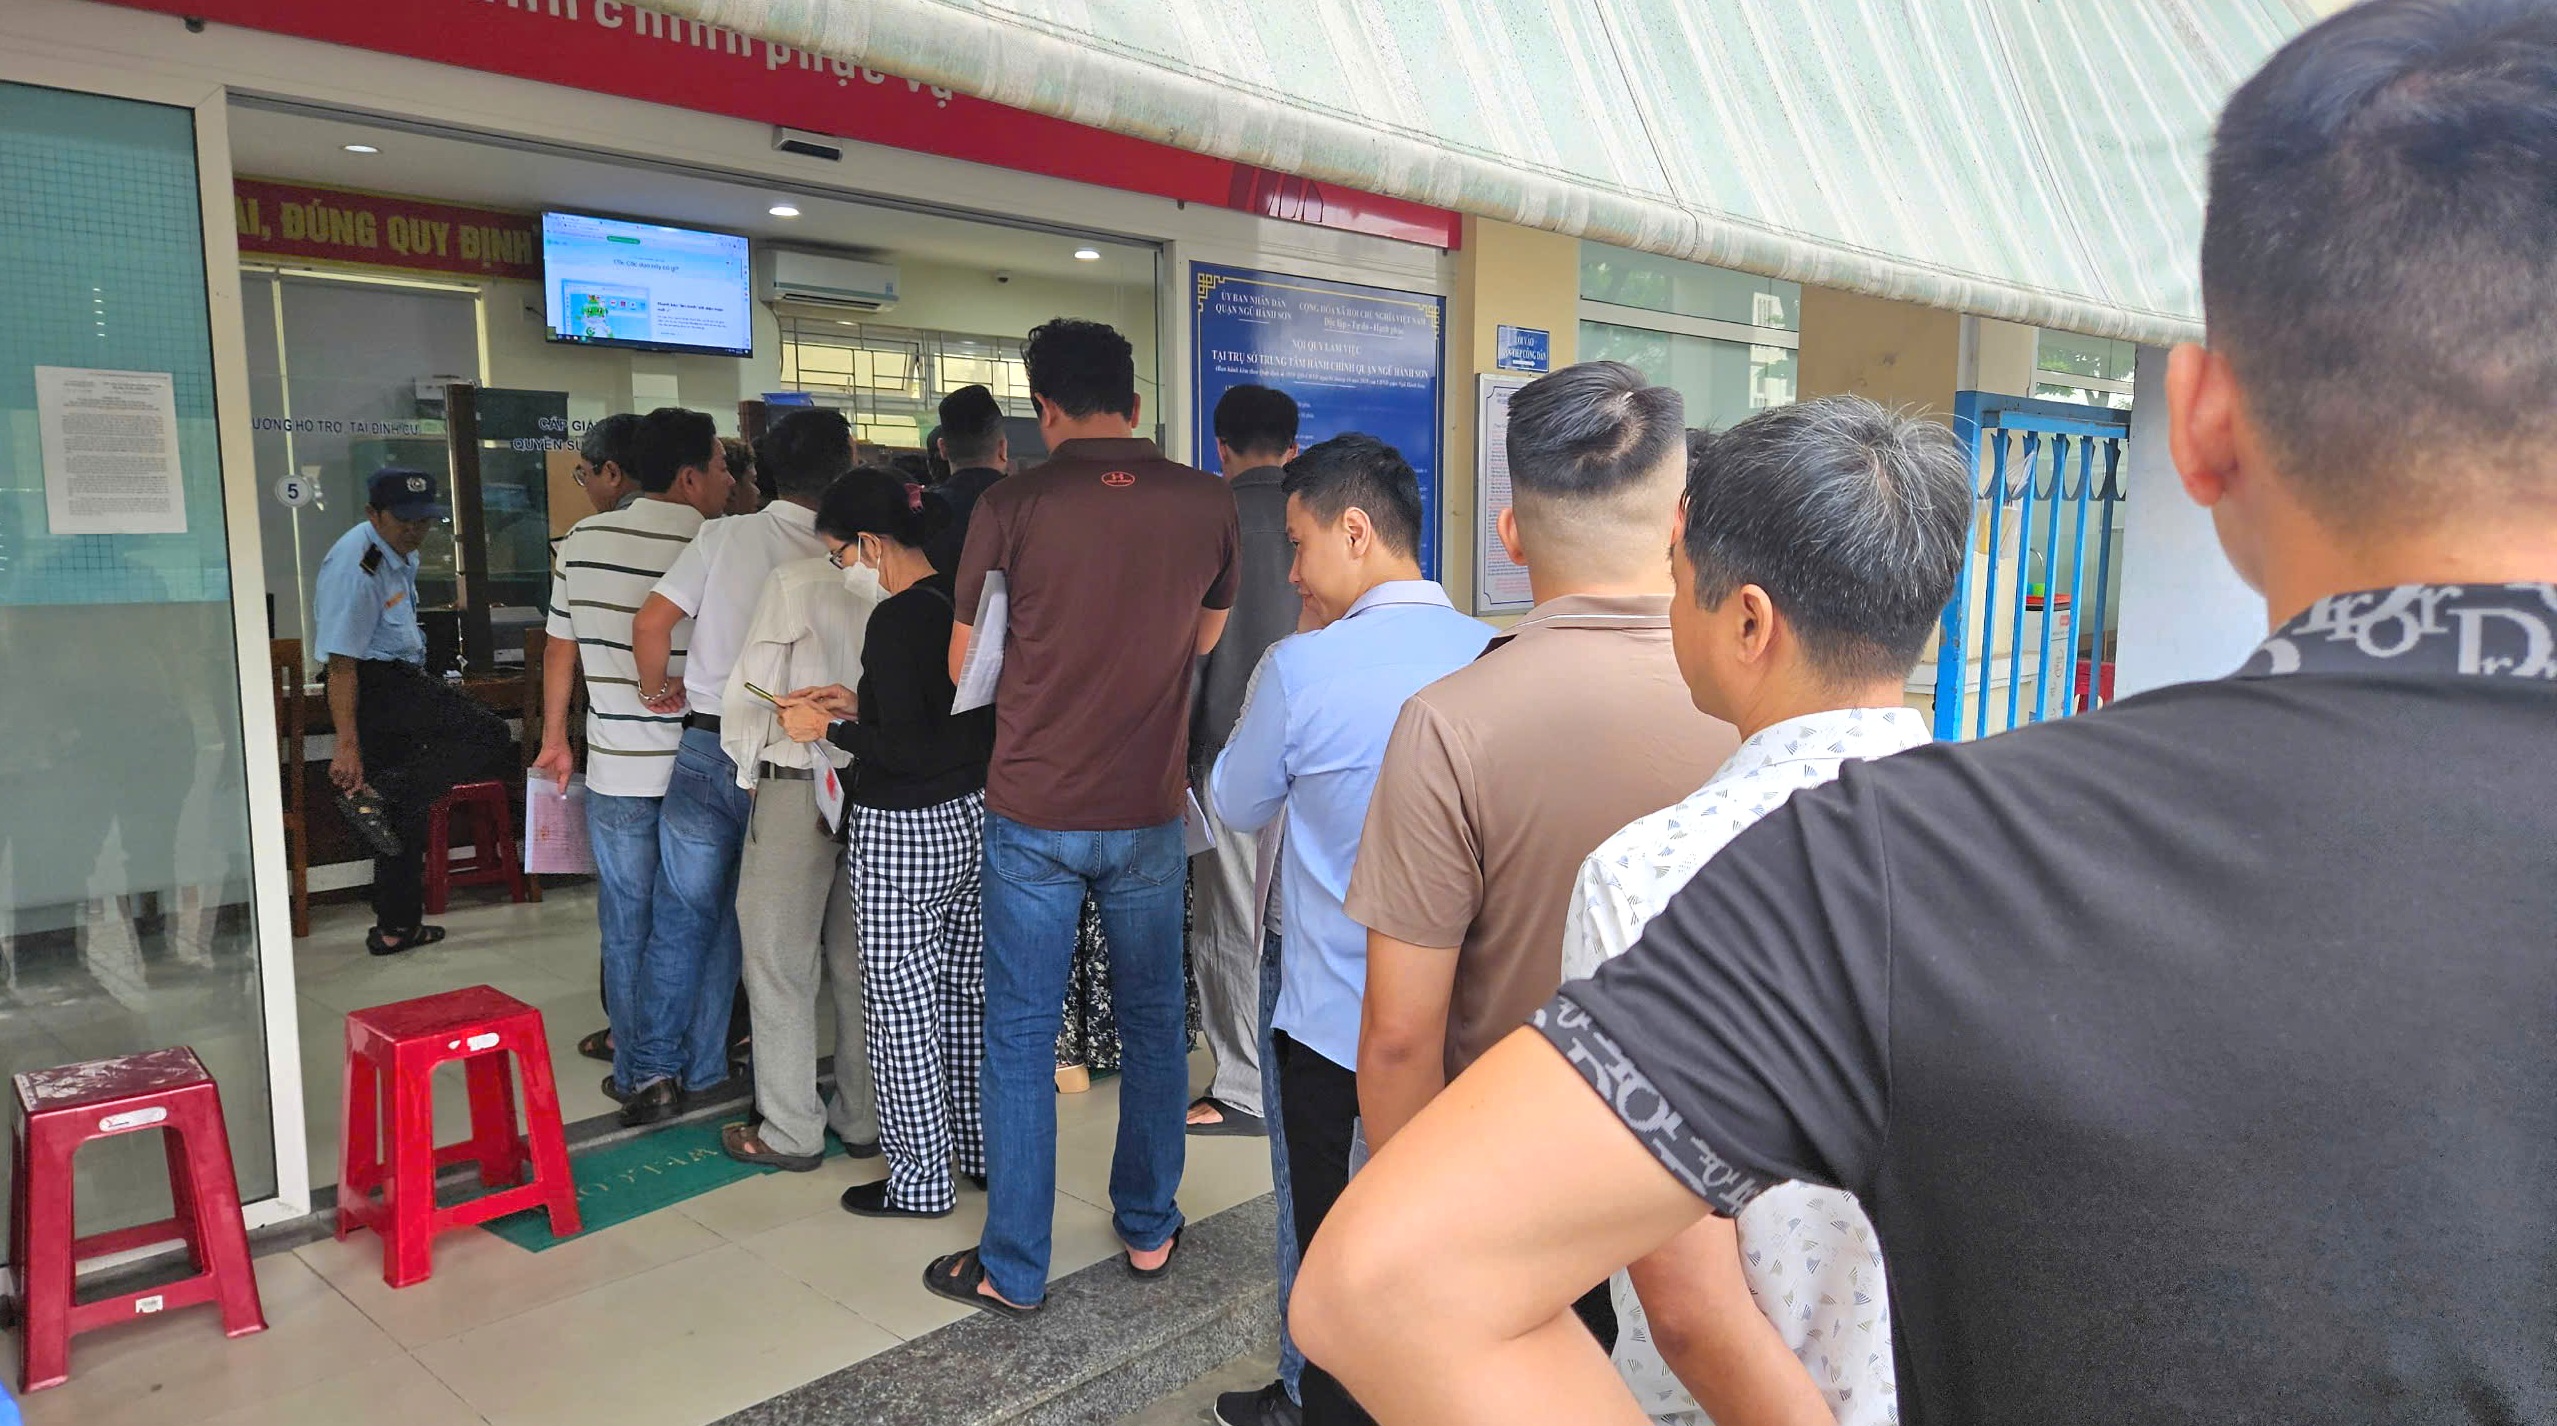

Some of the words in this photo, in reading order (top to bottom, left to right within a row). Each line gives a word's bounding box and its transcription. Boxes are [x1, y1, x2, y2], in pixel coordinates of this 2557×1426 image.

[280, 199, 377, 248] ĐÚNG
[387, 214, 450, 257] QUY
[459, 223, 534, 268] ĐỊNH
[1233, 293, 1249, 303] BAN
[1250, 295, 1270, 307] NHÂN
[1271, 298, 1287, 308] DÂN
[1215, 302, 1237, 315] QUẬN
[1238, 305, 1254, 317] NGŨ
[1255, 307, 1276, 319] HÀNH
[1212, 350, 1226, 363] TẠI
[1228, 351, 1245, 365] TRỤ
[1246, 351, 1258, 364] SỞ
[1259, 354, 1287, 366] TRUNG
[1289, 356, 1306, 368] TÂM
[1307, 358, 1329, 370] HÀNH
[1330, 359, 1355, 373] CHÍNH
[1356, 363, 1377, 376] QUẬN
[1379, 364, 1394, 377] NGŨ
[1394, 366, 1414, 378] HÀNH
[1415, 368, 1429, 380] SƠN
[287, 483, 299, 500] 5
